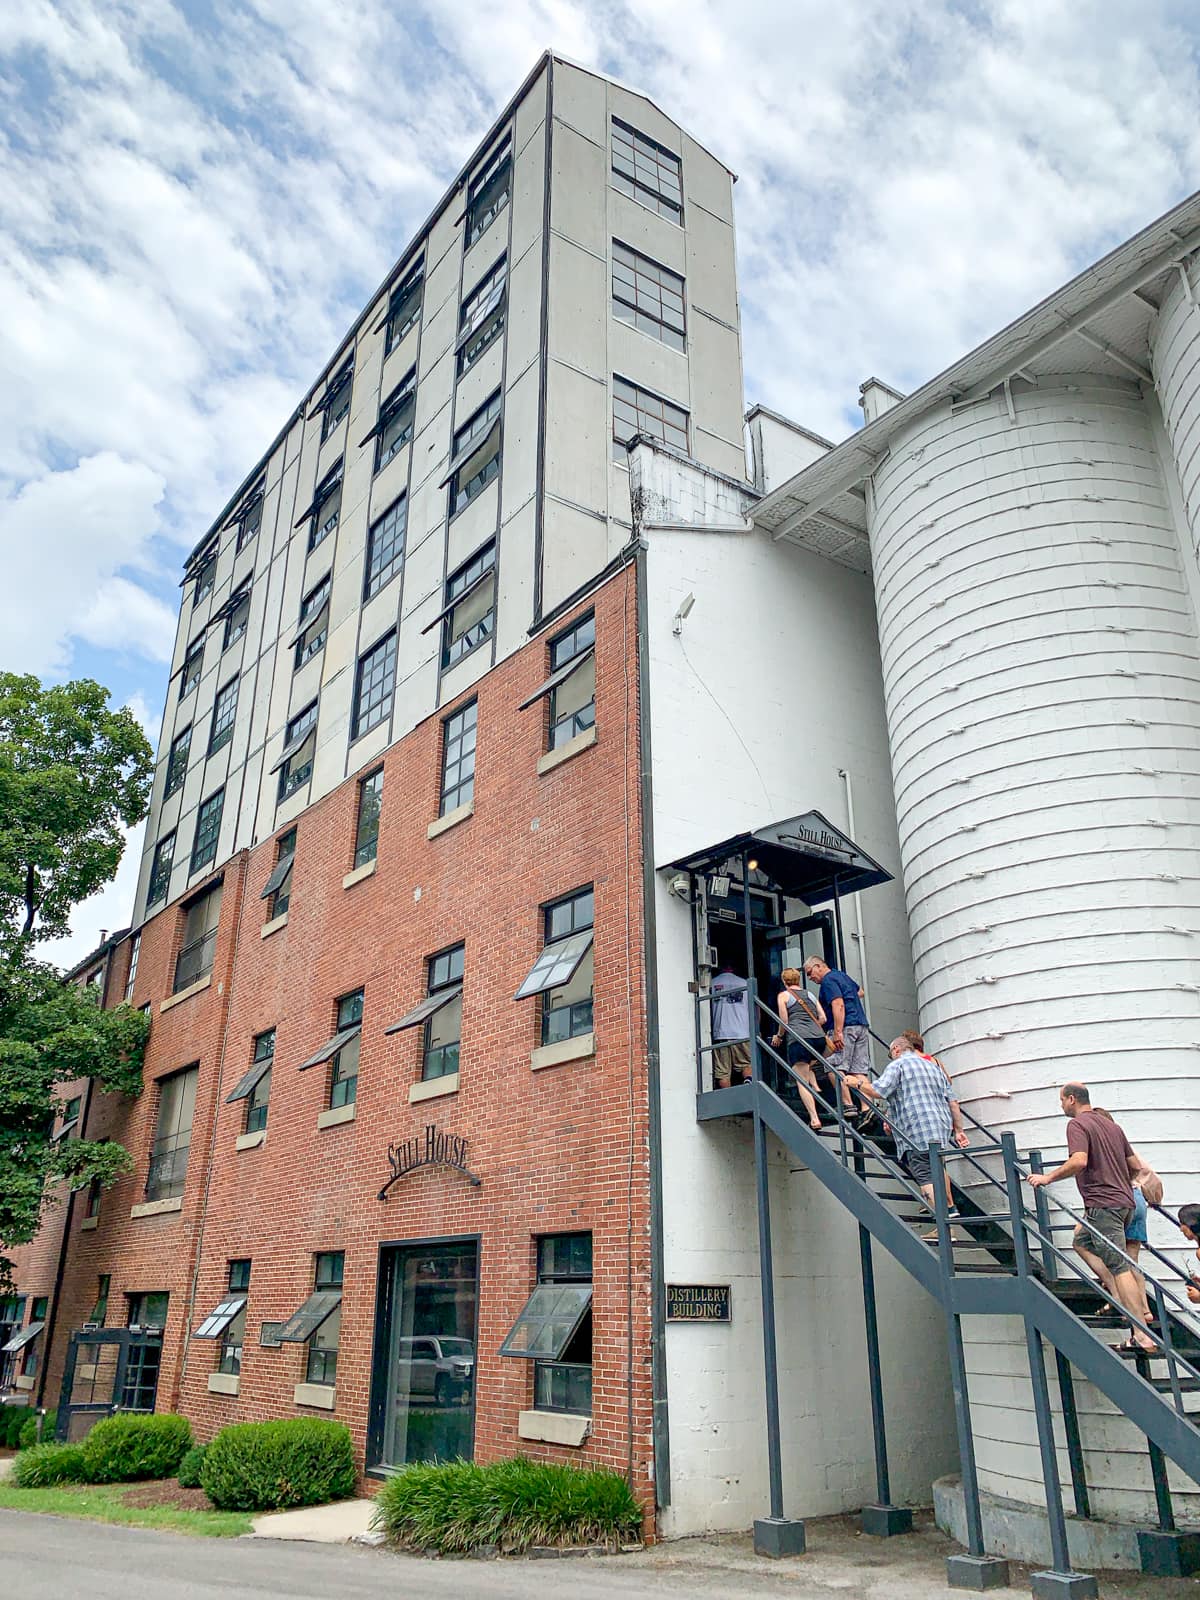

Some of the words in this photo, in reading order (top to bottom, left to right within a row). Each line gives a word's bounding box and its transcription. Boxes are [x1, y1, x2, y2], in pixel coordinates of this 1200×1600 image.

[798, 823, 819, 842] STILL
[387, 1135, 422, 1180] STILL
[422, 1124, 469, 1170] HOUSE
[668, 1288, 727, 1302] DISTILLERY
[672, 1303, 722, 1317] BUILDING
